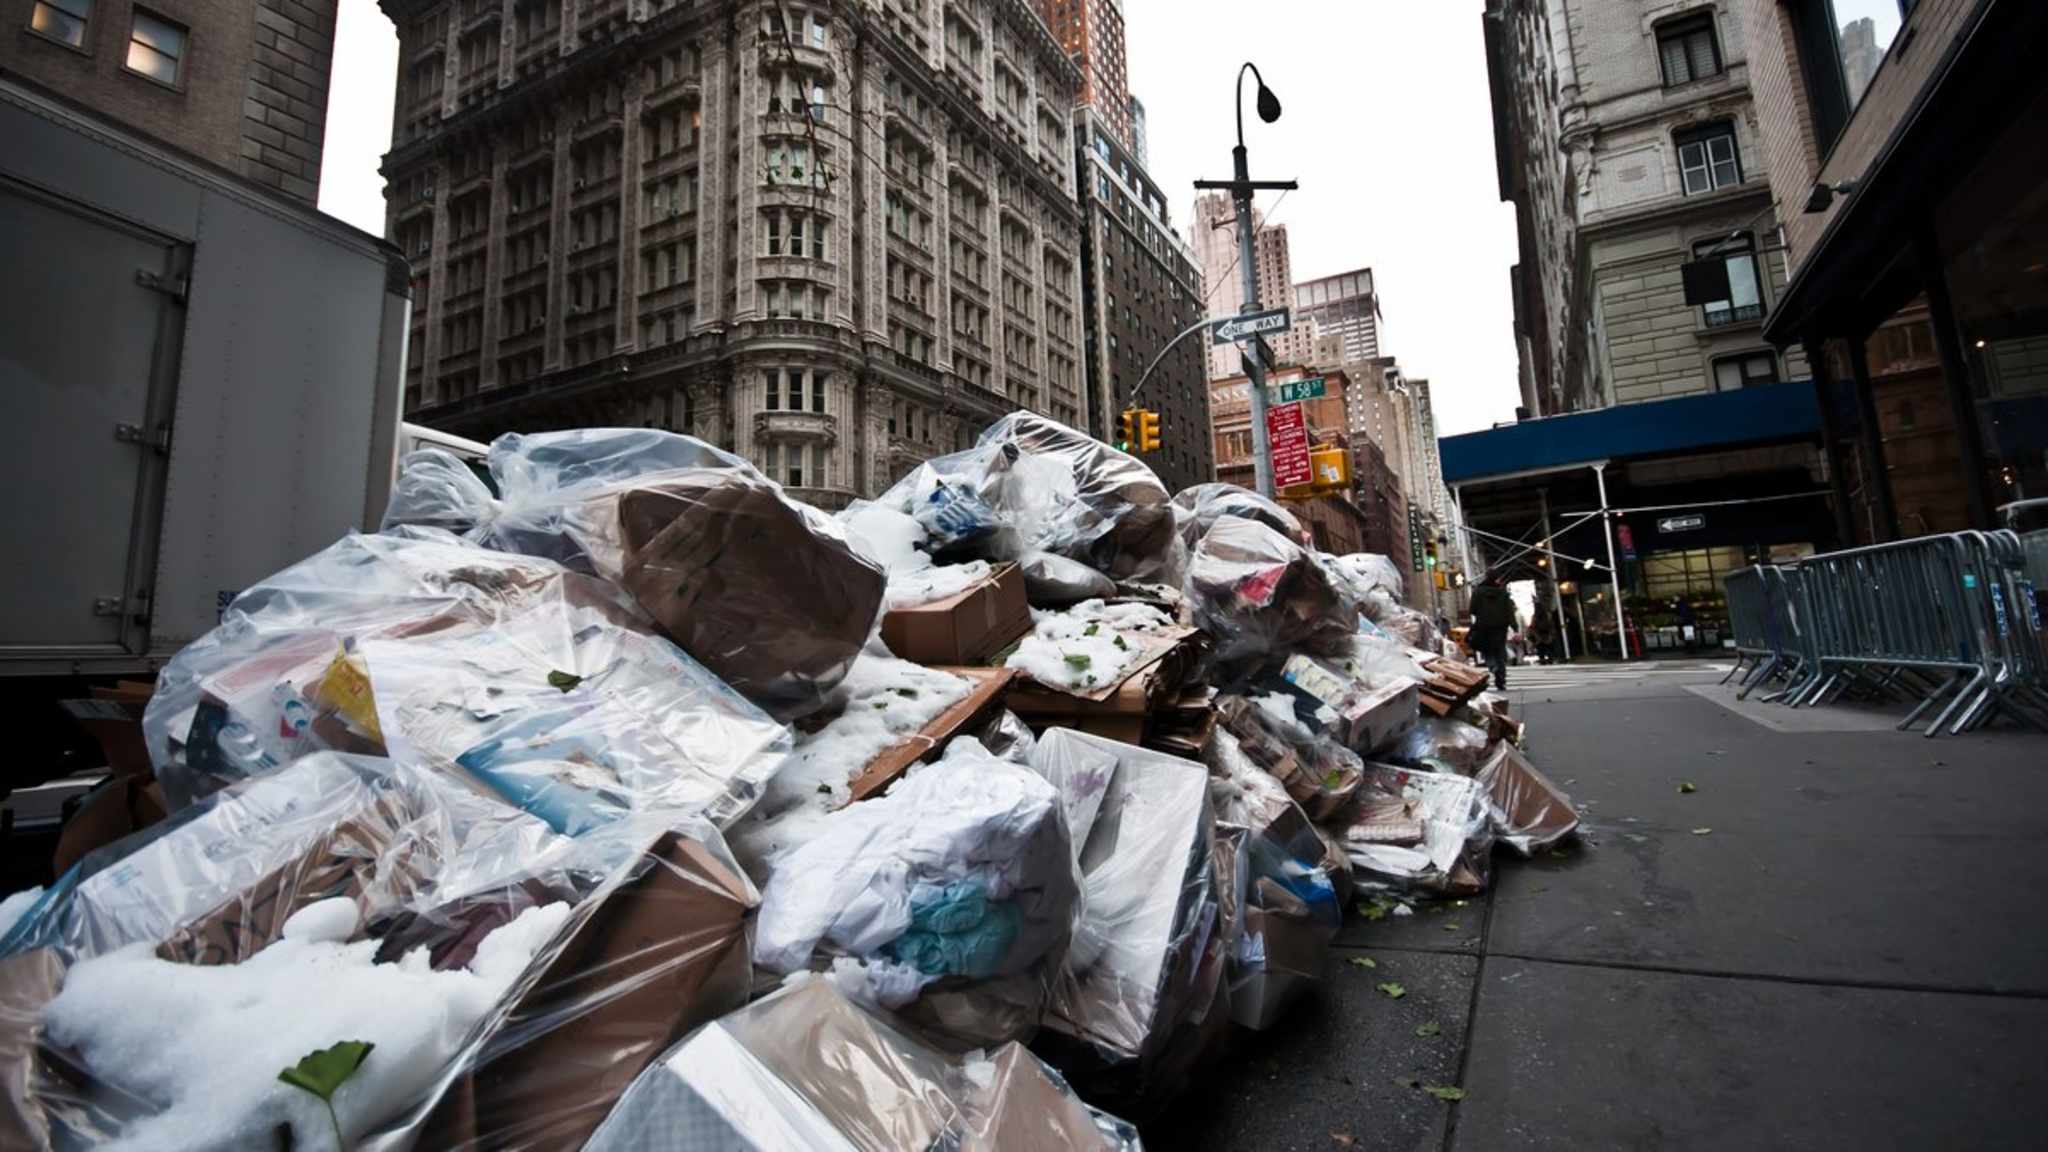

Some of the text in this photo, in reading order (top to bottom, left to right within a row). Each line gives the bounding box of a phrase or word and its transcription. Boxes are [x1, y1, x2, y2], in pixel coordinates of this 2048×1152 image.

[1224, 316, 1280, 336] ONE WAY
[1283, 385, 1293, 400] W
[1297, 382, 1311, 398] 58
